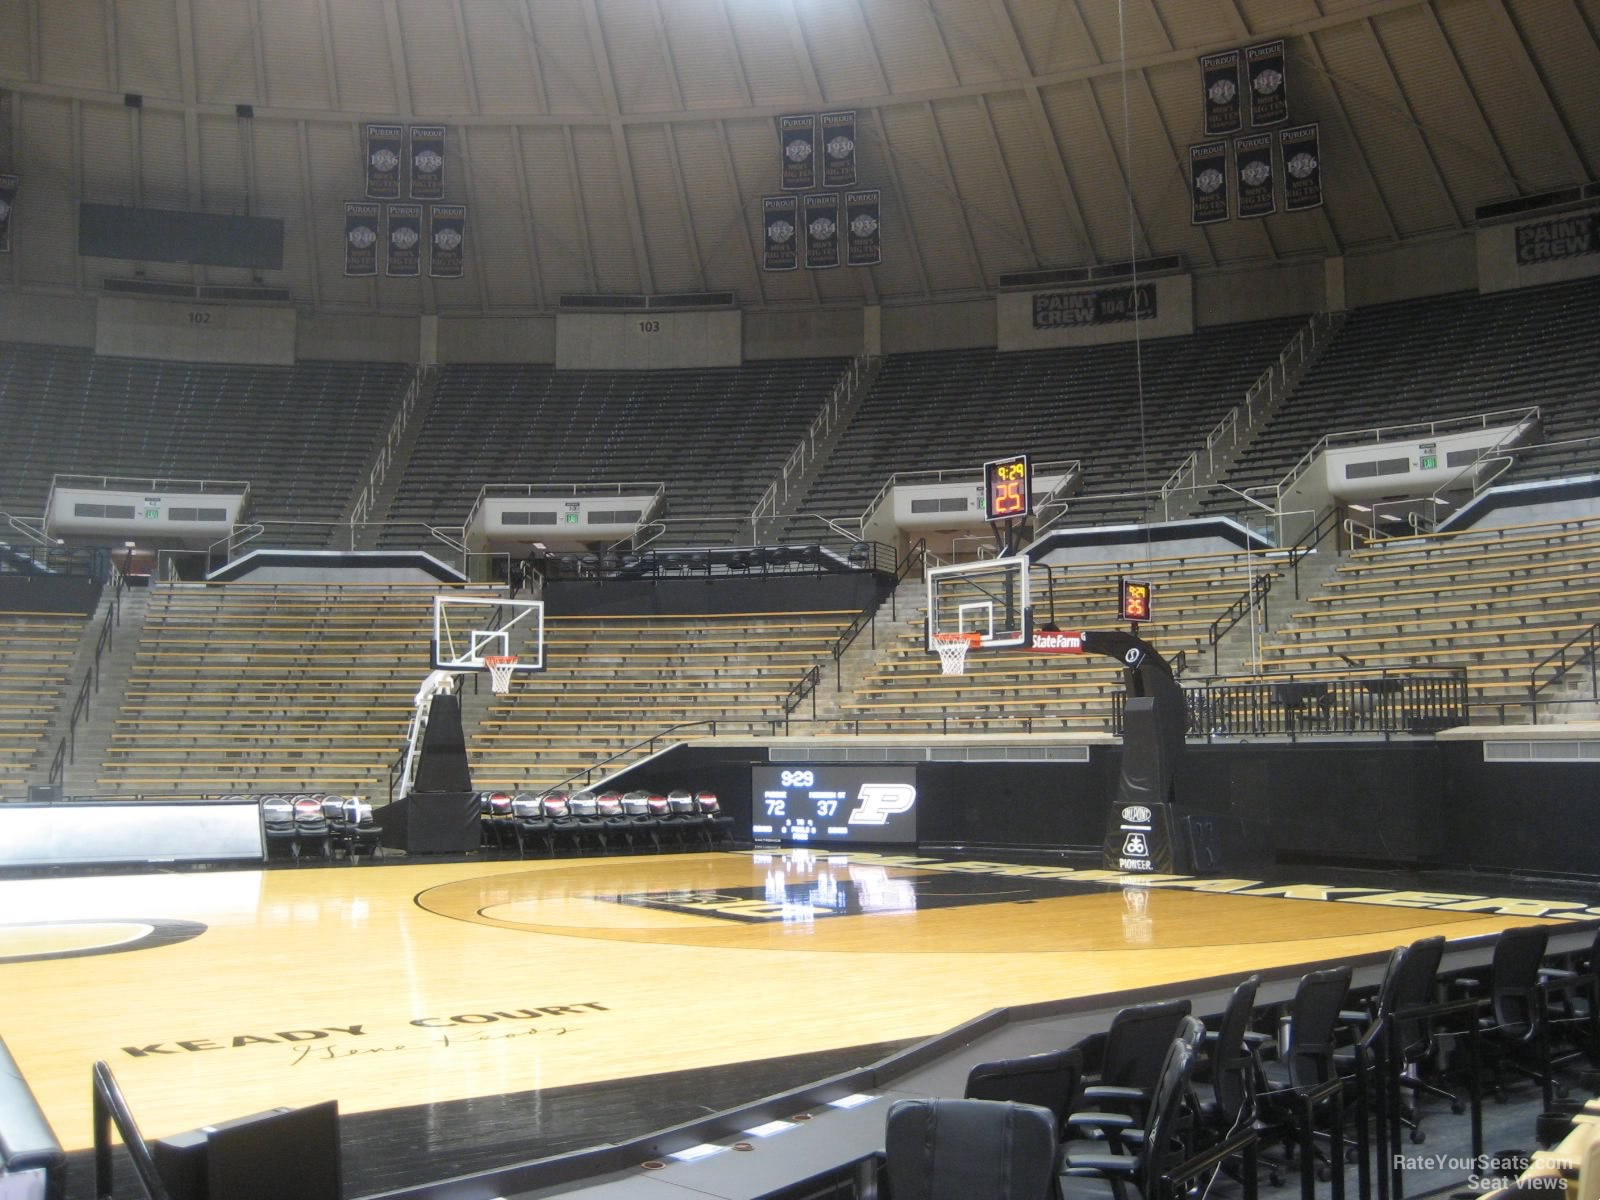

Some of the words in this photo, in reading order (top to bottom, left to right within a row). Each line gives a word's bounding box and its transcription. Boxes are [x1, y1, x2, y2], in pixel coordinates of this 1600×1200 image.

[1248, 45, 1282, 58] PURDUE
[1204, 55, 1237, 67] PURDUE
[783, 118, 812, 127] PURDUE
[823, 115, 853, 124] PURDUE
[370, 128, 400, 136] PURDUE
[413, 129, 442, 137] PURDUE
[1282, 128, 1315, 141] PURDUE
[827, 140, 854, 153] 1930
[1237, 137, 1270, 149] PURDUE
[1192, 145, 1224, 157] PURDUE
[1287, 158, 1317, 173] 1926
[1241, 165, 1270, 181] 1922
[765, 200, 794, 209] PURDUE
[807, 197, 836, 205] PURDUE
[848, 194, 877, 202] PURDUE
[347, 205, 377, 214] PURDUE
[389, 206, 419, 214] PURDUE
[433, 207, 463, 216] PURDUE
[809, 222, 836, 234] 1934
[850, 219, 877, 232] 1935
[1519, 217, 1592, 245] PAINT
[1520, 234, 1591, 260] CREW
[1037, 294, 1097, 311] PAINT
[1101, 301, 1124, 314] 104
[188, 312, 210, 323] 102
[1037, 308, 1096, 325] CREW
[639, 320, 660, 333] 103
[998, 463, 1024, 480] 9:29
[996, 482, 1020, 512] 25
[1127, 599, 1145, 614] 25
[765, 800, 786, 816] 72
[817, 800, 838, 817] 37
[120, 1024, 367, 1057] KEADY
[409, 1001, 611, 1028] COURT
